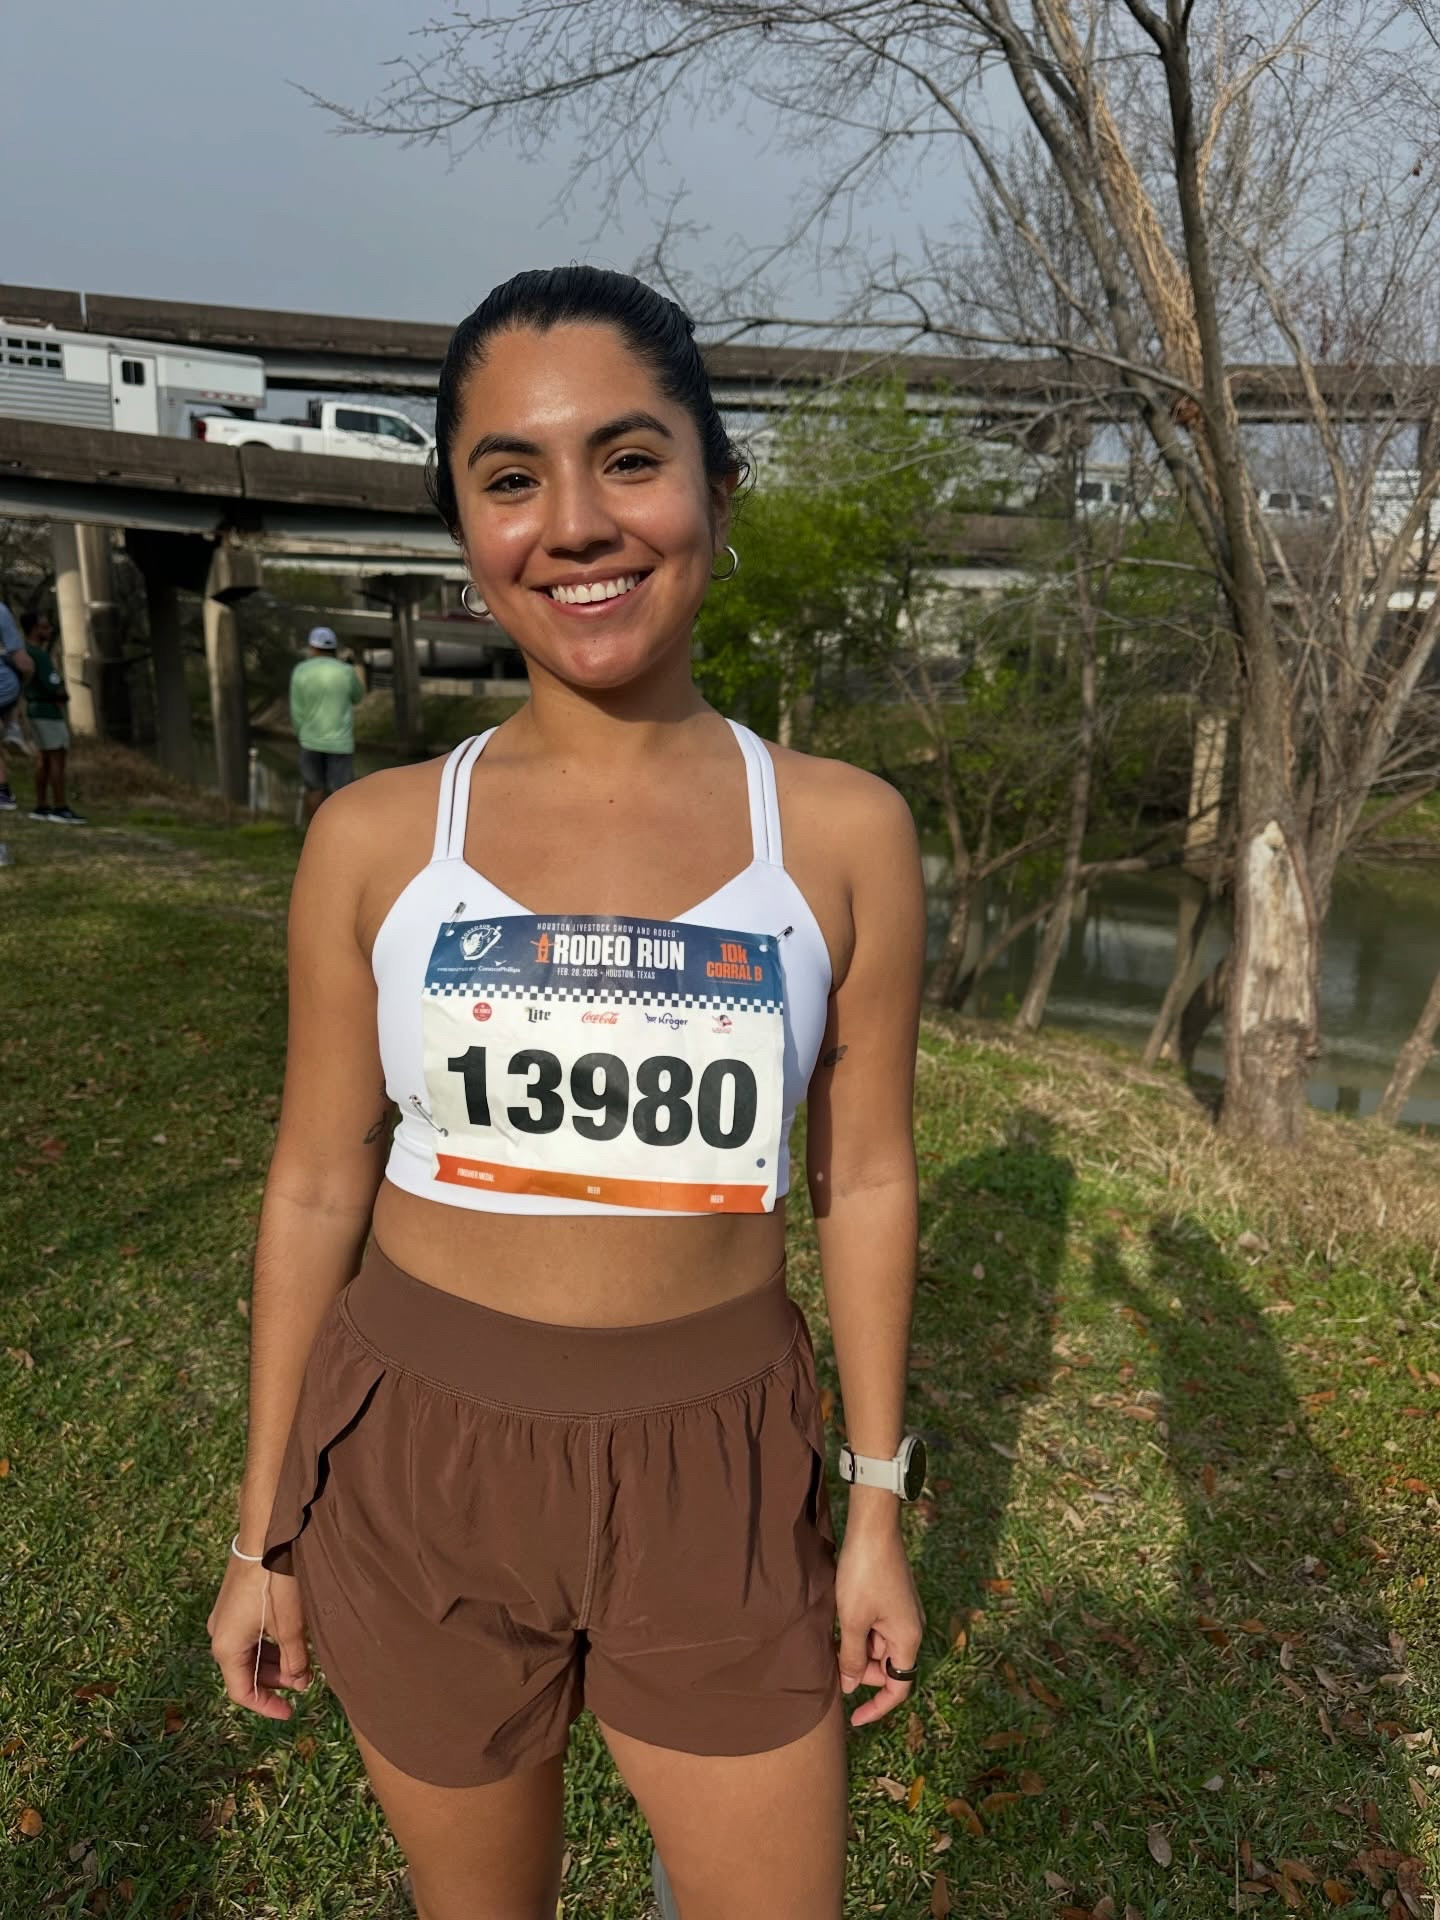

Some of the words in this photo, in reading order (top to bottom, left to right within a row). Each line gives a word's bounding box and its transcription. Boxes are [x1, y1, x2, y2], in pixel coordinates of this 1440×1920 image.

[537, 922, 570, 931] HOUSTON
[573, 923, 610, 932] LIVESTOCK
[613, 924, 633, 933] SHOW
[637, 926, 650, 935] AND
[553, 933, 631, 967] RODEO
[637, 937, 685, 971] RUN
[582, 968, 598, 977] 2026
[637, 970, 656, 980] TEXAS
[706, 960, 752, 981] CORRAL
[754, 966, 763, 982] B
[525, 1006, 551, 1023] Lite
[658, 1013, 688, 1030] Kroger
[448, 1046, 757, 1149] 13980
